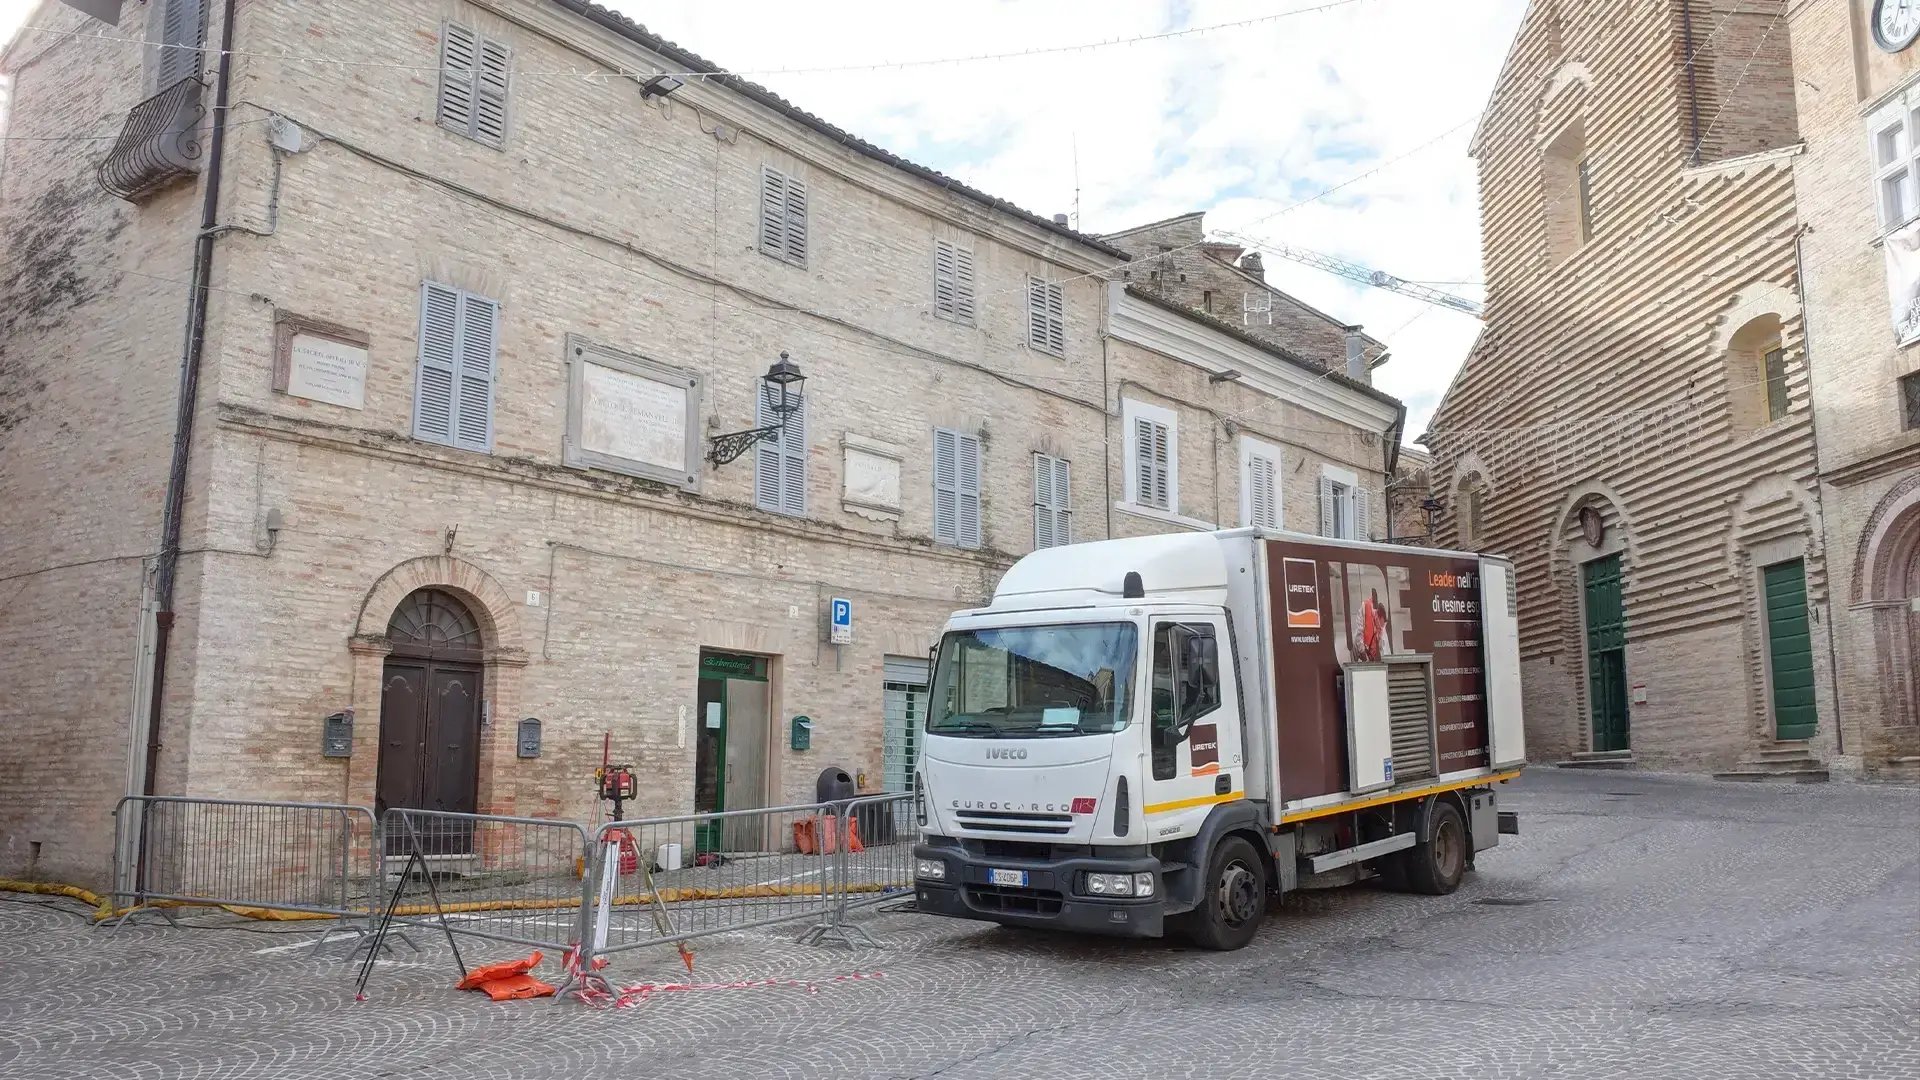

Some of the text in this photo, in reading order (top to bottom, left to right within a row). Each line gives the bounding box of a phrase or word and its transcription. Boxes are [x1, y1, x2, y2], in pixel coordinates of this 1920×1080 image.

[1429, 570, 1456, 588] Leader
[1289, 584, 1315, 593] URETEK
[1432, 594, 1440, 612] di
[1442, 596, 1465, 613] resine
[837, 603, 847, 621] P
[1291, 634, 1320, 643] www.uretek.it
[704, 656, 751, 670] Erboristeria
[1192, 742, 1217, 751] URETEK
[985, 747, 1028, 760] IVECO
[952, 800, 1070, 812] EUROCARGO
